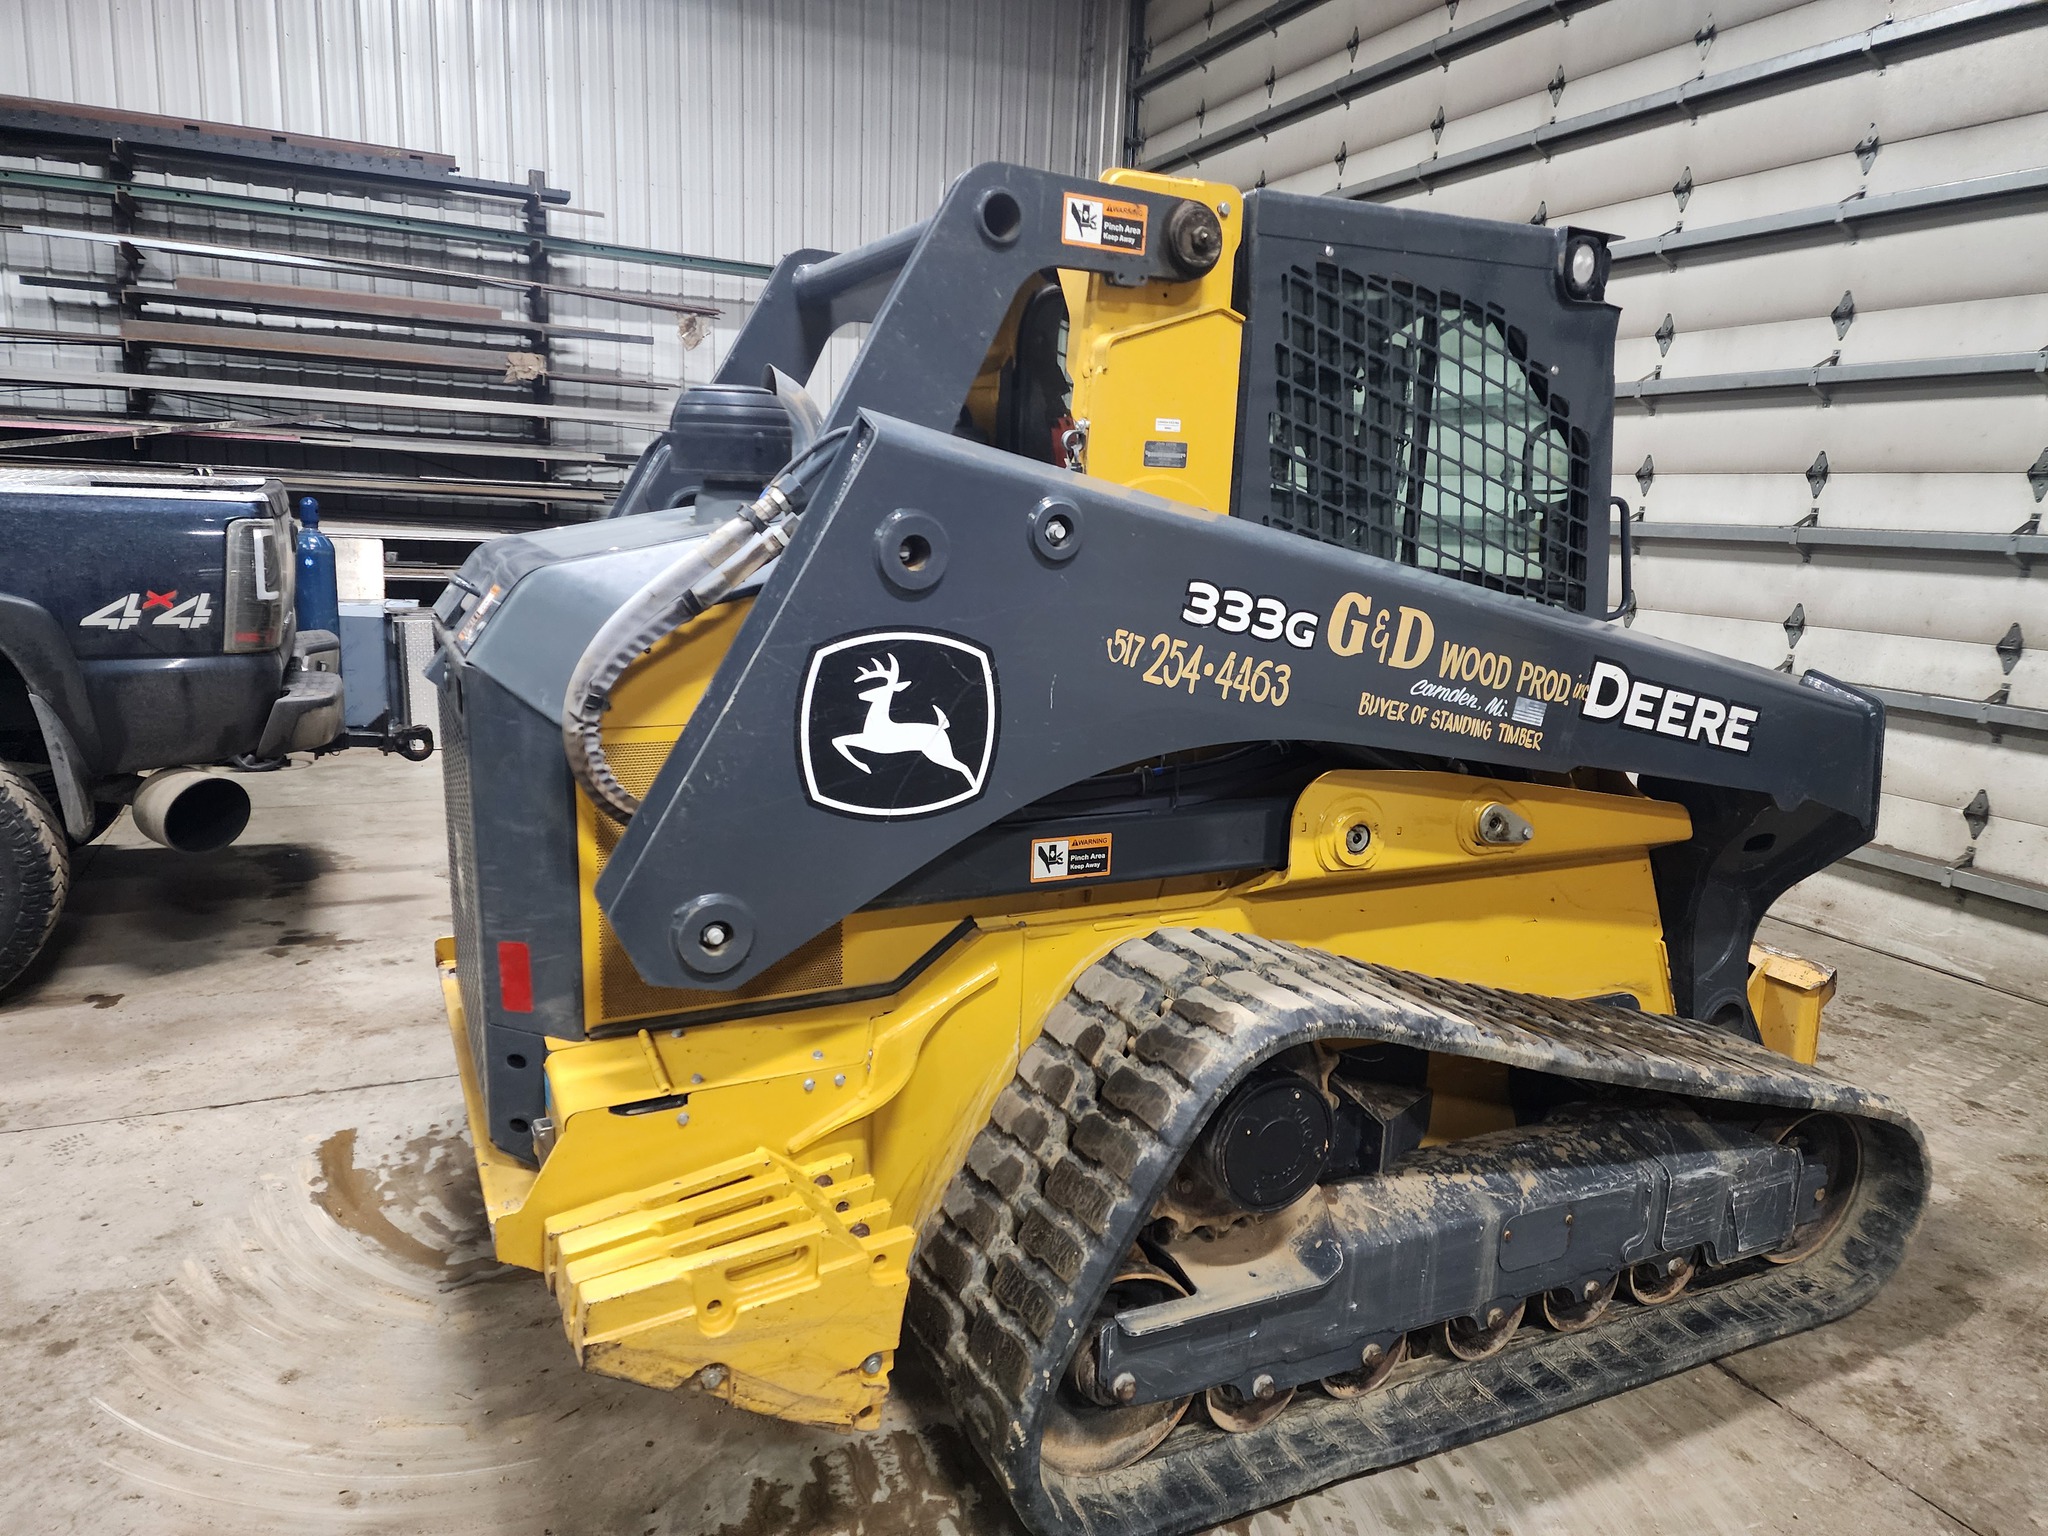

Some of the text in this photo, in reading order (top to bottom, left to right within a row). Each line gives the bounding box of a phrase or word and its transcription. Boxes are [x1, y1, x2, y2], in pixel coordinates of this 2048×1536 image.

[1103, 232, 1136, 245] Keep Away
[1104, 222, 1141, 235] Pinch Area
[1182, 581, 1320, 649] 333G
[1106, 628, 1146, 668] 517
[1327, 591, 1435, 669] G&D
[1438, 640, 1512, 690] WOOD
[1516, 660, 1572, 706] PROD.
[1410, 679, 1509, 717] Camden, Mi.
[1582, 661, 1759, 752] DEERE
[1358, 692, 1544, 751] BUYER OF STANDING TIMBER
[1078, 837, 1108, 846] WARNING
